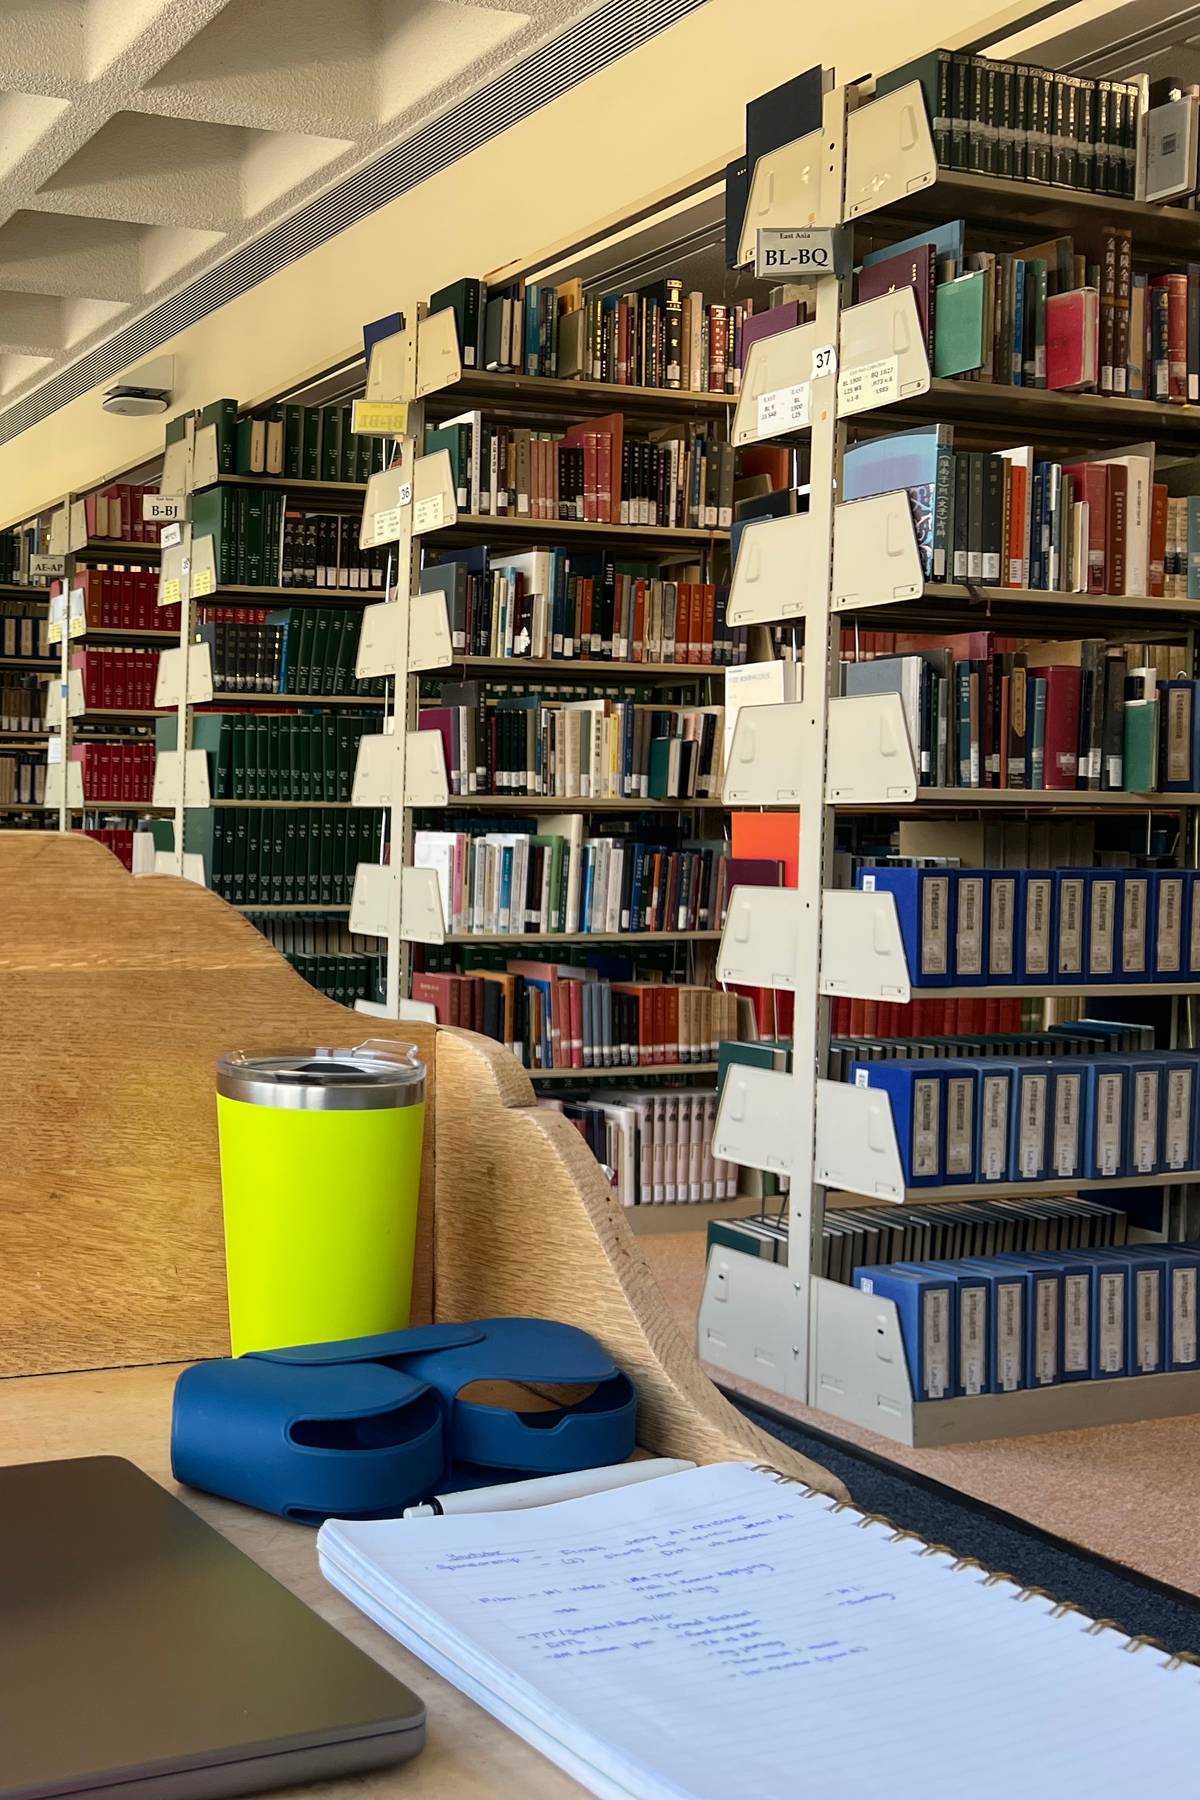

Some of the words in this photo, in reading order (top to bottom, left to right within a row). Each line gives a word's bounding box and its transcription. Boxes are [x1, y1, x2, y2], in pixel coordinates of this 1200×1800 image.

[765, 248, 828, 267] BL-BQ
[816, 350, 830, 368] 37
[401, 487, 410, 500] 36
[152, 505, 178, 518] B-BJ
[35, 563, 63, 571] AE-AP
